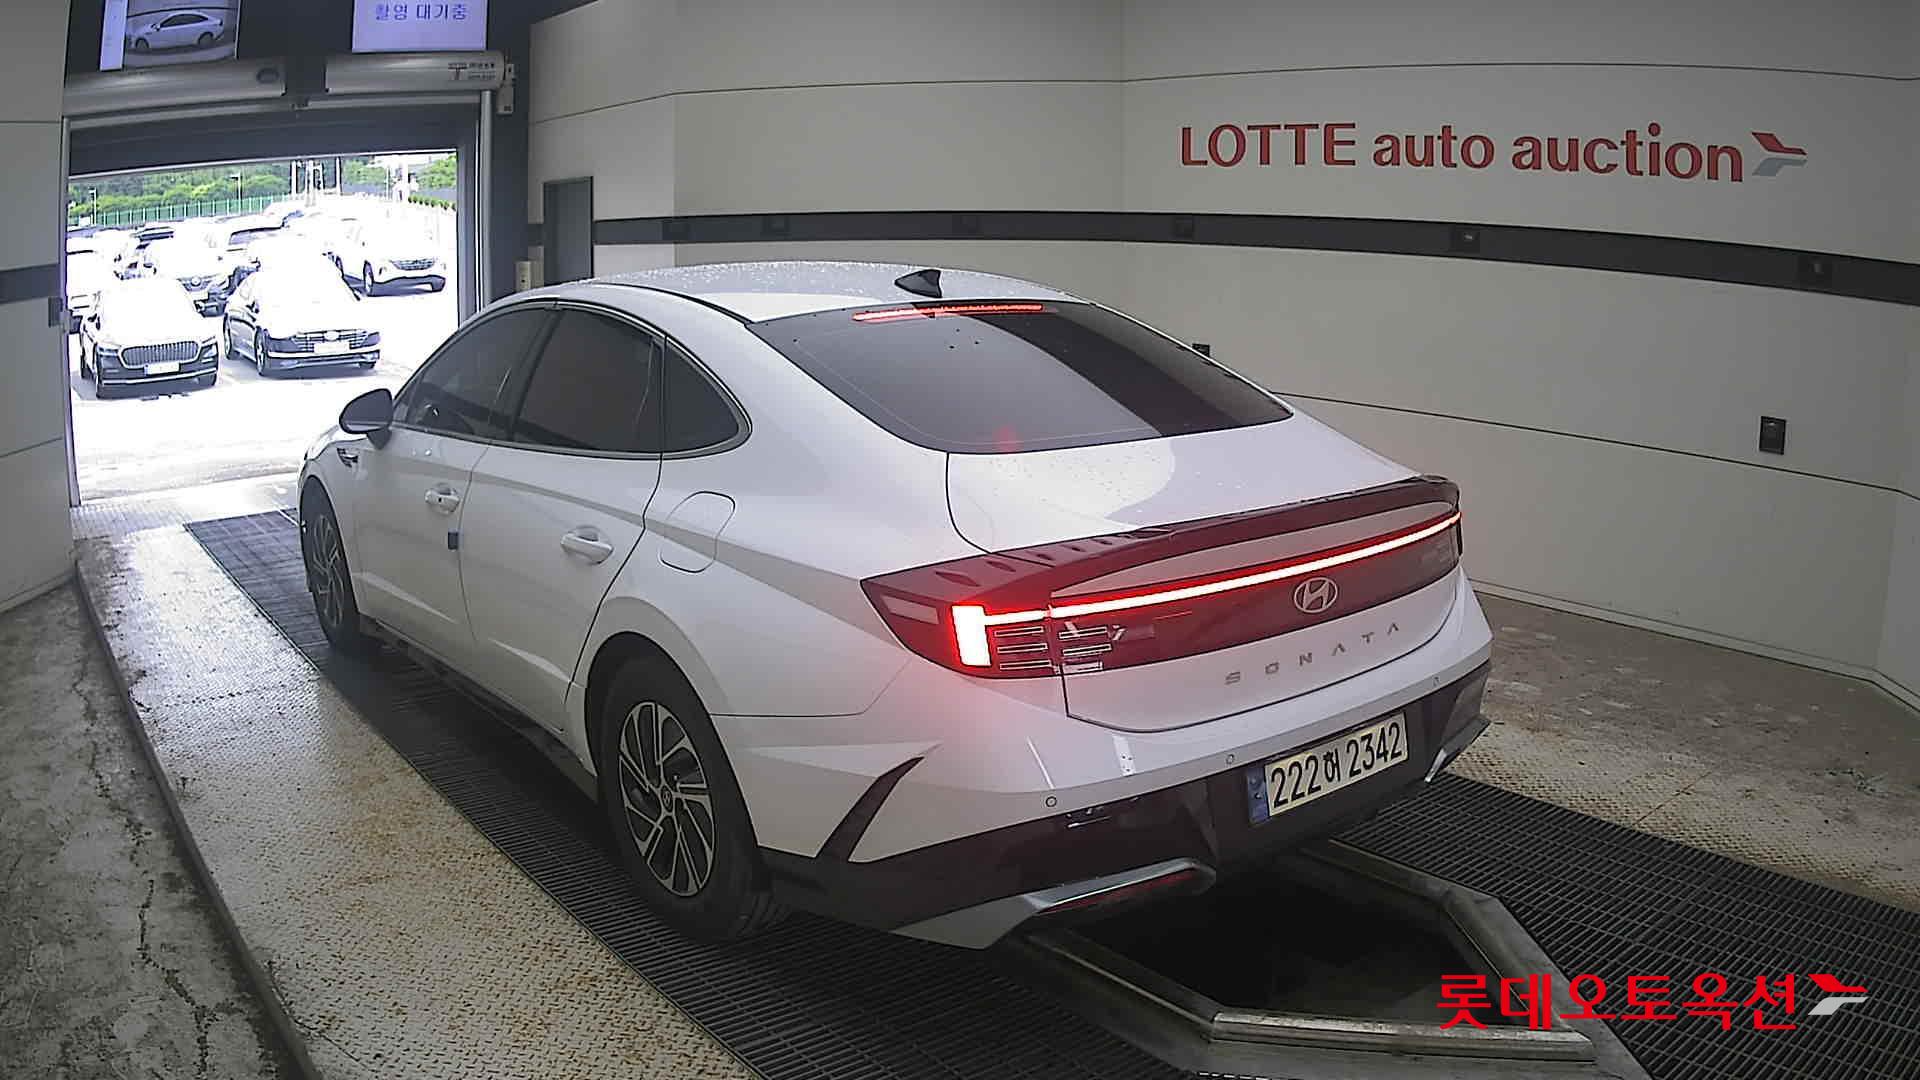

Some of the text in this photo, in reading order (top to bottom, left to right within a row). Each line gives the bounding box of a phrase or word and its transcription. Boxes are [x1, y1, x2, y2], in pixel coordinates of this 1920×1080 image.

[416, 4, 467, 21] 대기중
[1180, 122, 1744, 183] LOTTE auto auction
[1224, 622, 1400, 686] SONATA
[1270, 721, 1402, 809] 222허 2342
